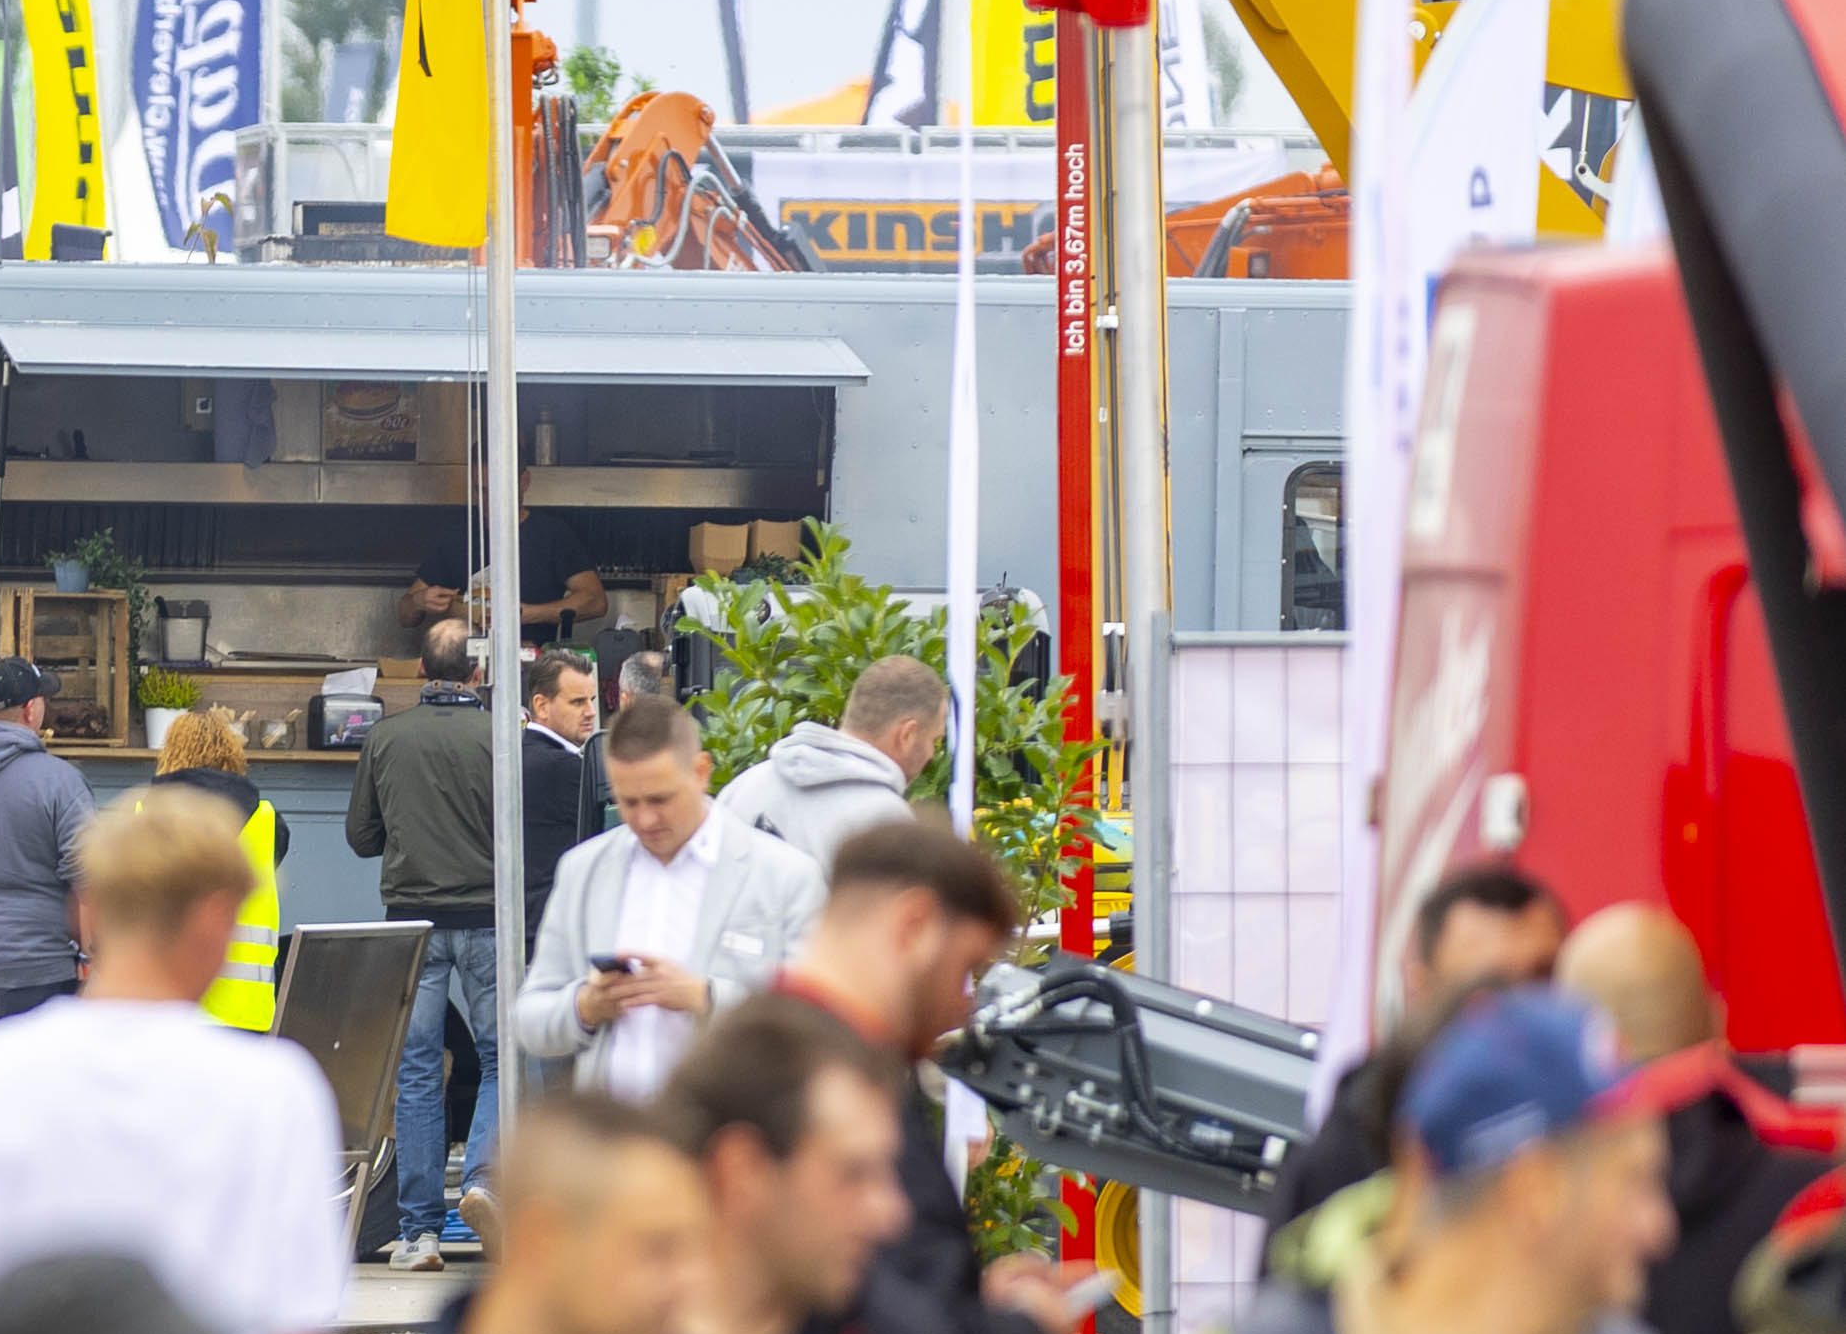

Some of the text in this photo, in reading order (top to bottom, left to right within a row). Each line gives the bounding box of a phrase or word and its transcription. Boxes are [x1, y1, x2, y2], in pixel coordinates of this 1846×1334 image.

[1064, 142, 1088, 357] Ich bin 3,67m hoch
